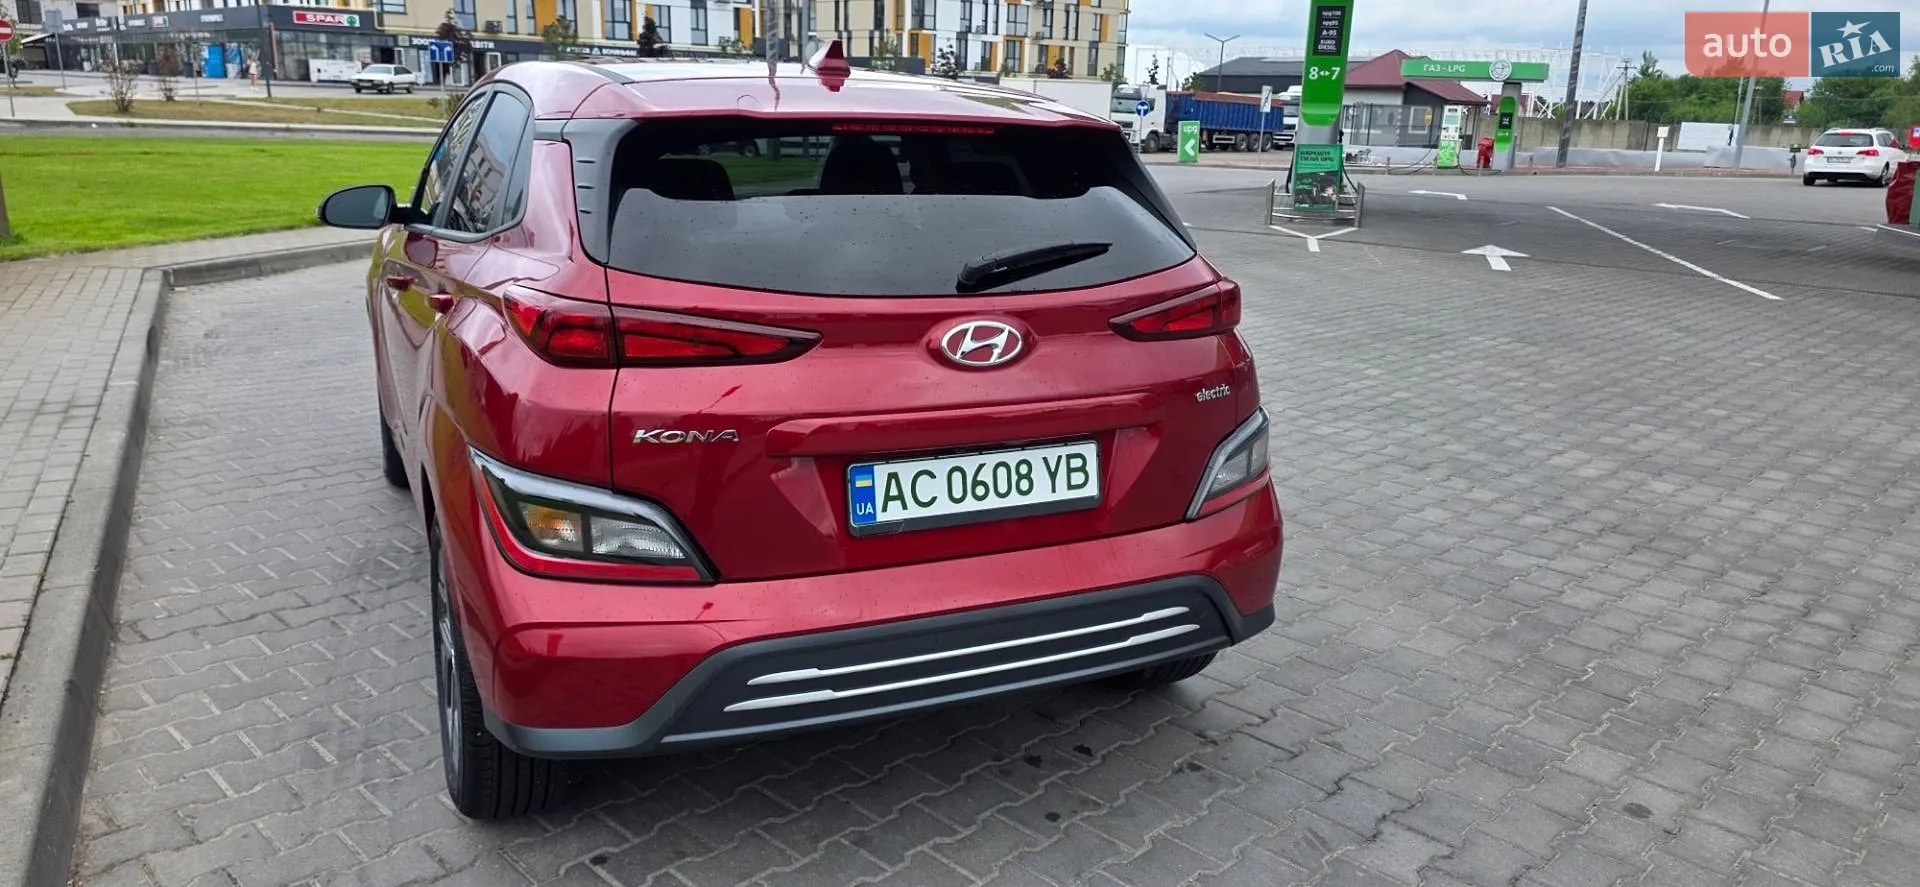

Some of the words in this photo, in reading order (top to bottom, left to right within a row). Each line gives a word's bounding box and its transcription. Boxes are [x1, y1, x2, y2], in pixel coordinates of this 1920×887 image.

[305, 14, 345, 24] SPAR
[1308, 66, 1319, 80] 8
[1331, 67, 1341, 80] 7
[1423, 63, 1441, 72] ГАЗ
[1447, 64, 1466, 73] LPG
[1183, 125, 1198, 134] upg
[1196, 383, 1231, 402] electric
[632, 429, 739, 443] KONA
[881, 469, 938, 512] AC
[946, 458, 1034, 504] 0608
[1042, 452, 1090, 493] YB
[856, 502, 874, 516] UA
